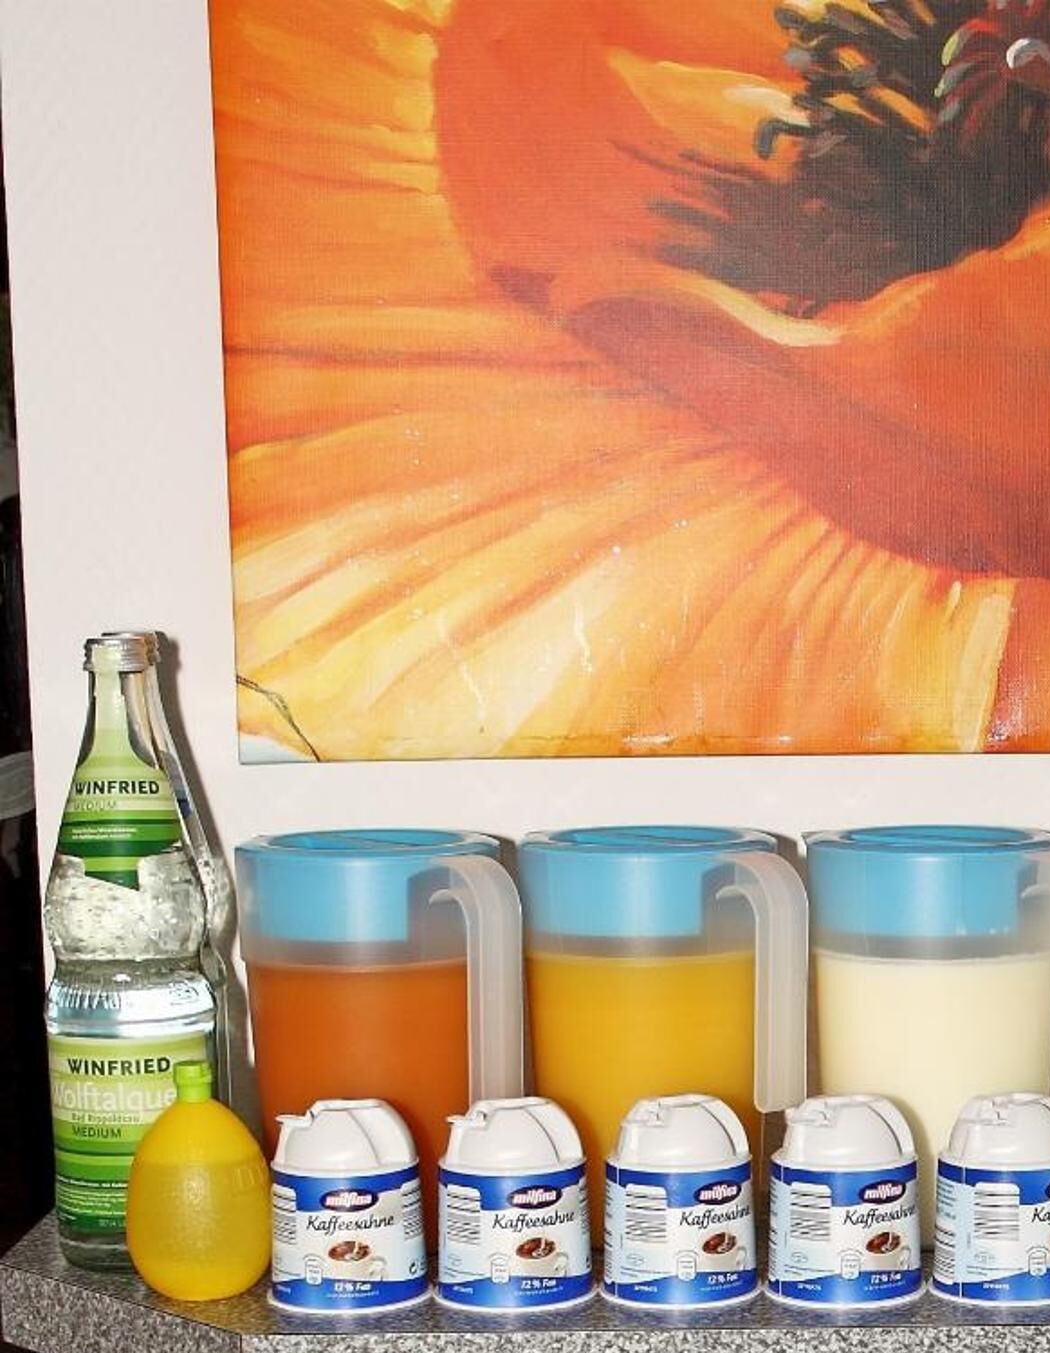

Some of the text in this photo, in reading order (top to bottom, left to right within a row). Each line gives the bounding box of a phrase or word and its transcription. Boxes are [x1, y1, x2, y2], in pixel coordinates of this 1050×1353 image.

[75, 780, 160, 795] WINFRIED
[67, 1057, 171, 1076] WINFRIED
[53, 1081, 178, 1113] Wolftalque
[72, 1125, 122, 1139] MEDIUM
[512, 1188, 557, 1206] milfina
[306, 1215, 395, 1236] Kaffeesahne
[492, 1210, 575, 1233] Kaffeesahne
